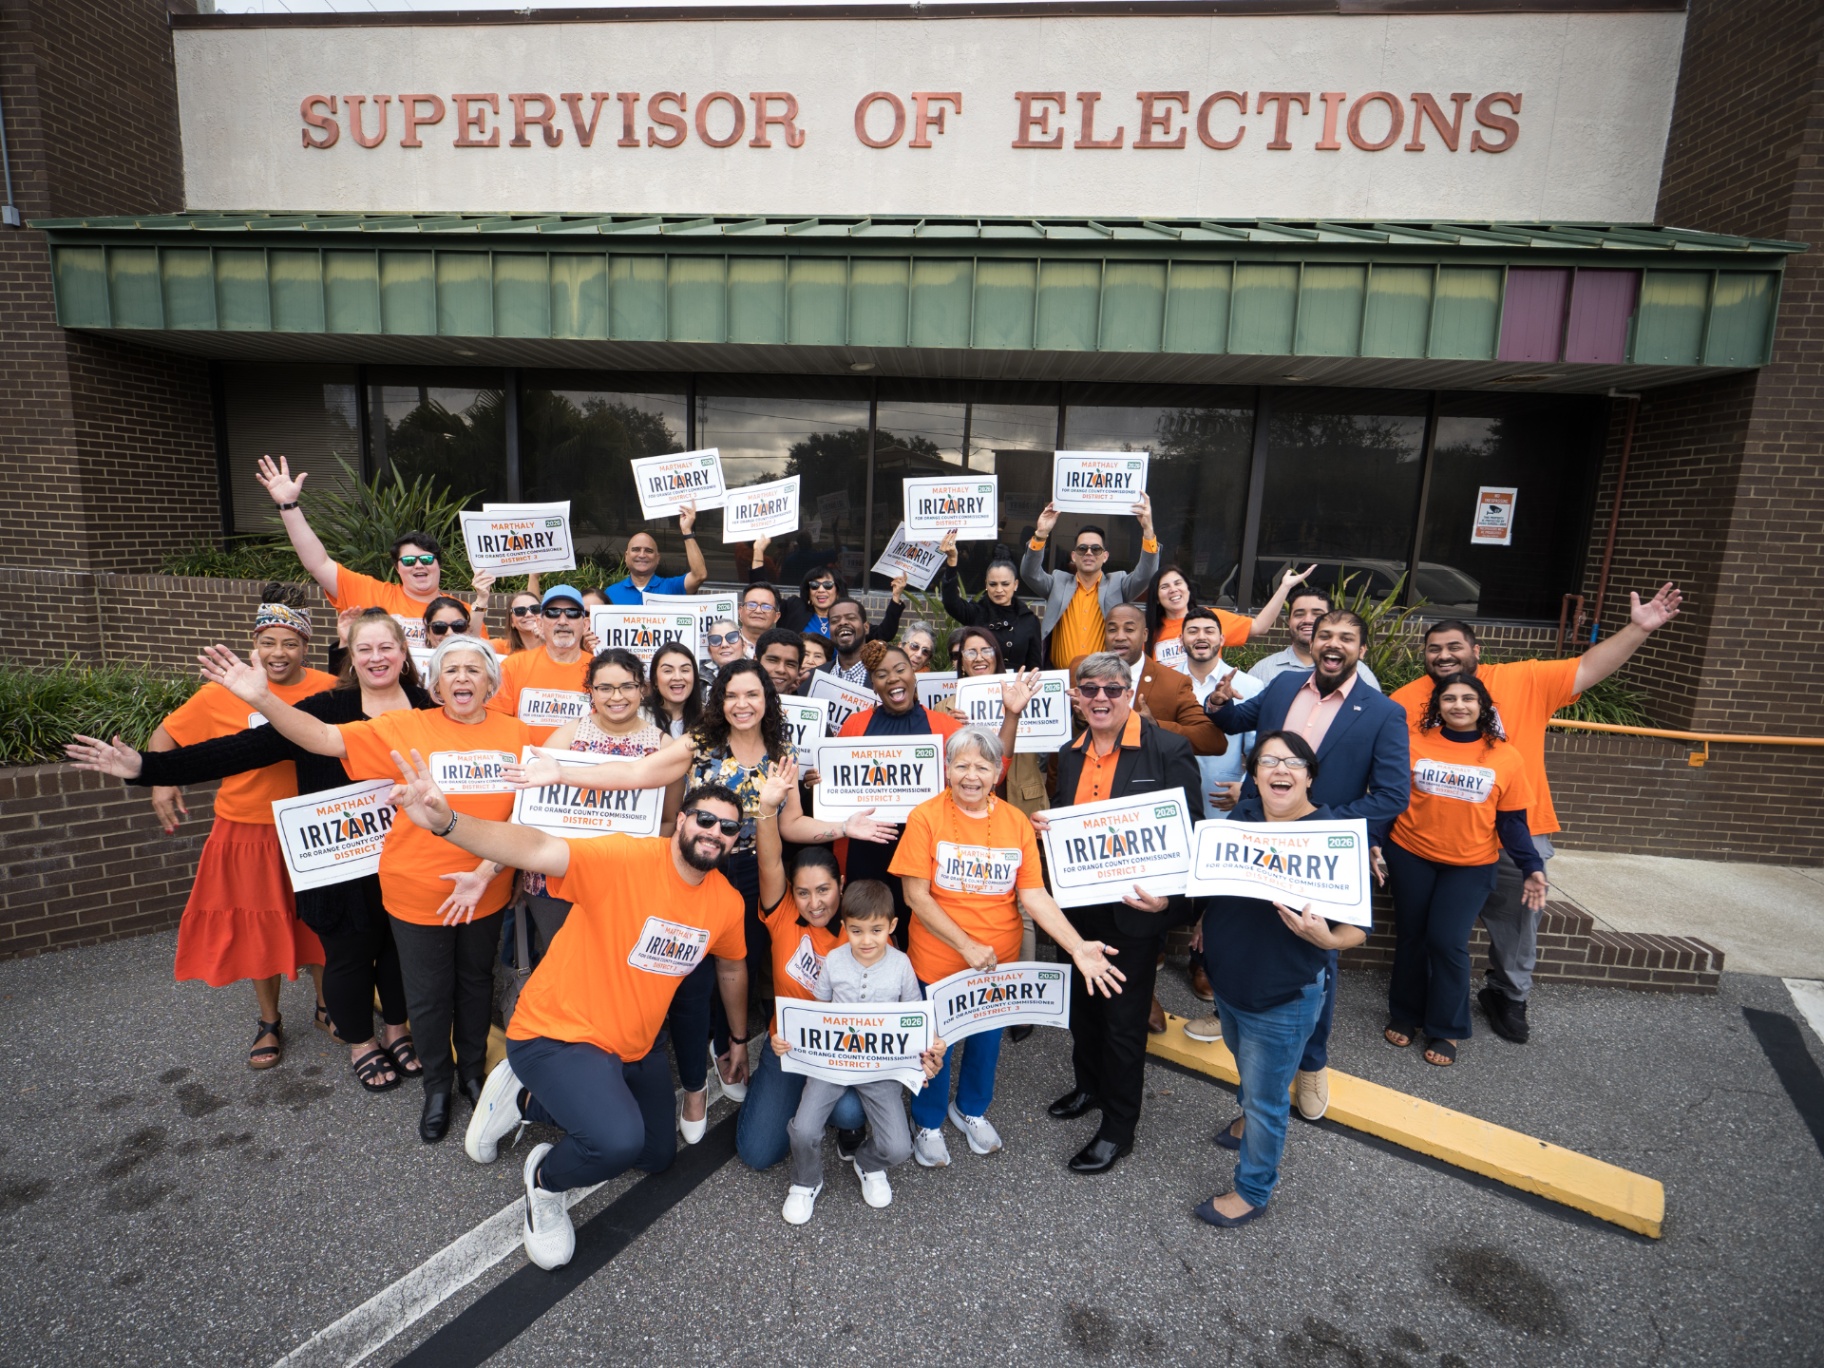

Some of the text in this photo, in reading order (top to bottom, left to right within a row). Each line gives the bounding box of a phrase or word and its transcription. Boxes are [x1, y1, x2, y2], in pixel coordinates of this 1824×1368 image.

[300, 91, 1523, 152] SUPERVISOR OF ELECTIONS
[660, 462, 692, 471] MARTHALY
[649, 469, 708, 492] IRIZARRY
[1067, 472, 1132, 488] IRIZARRY
[736, 497, 788, 519] IRIZARRY
[920, 497, 984, 514] IRIZARRY
[491, 522, 534, 530] MARTHALY
[478, 531, 553, 552] IRIZARRY
[893, 541, 935, 567] IRIZARRY
[607, 629, 682, 646] IRIZARRY
[528, 700, 583, 716] IRIZARRY
[852, 749, 933, 758] MARTHALY 2026
[834, 764, 923, 786] IRIZARRY
[1423, 769, 1483, 790] IRIZARRY
[316, 794, 376, 816] MARTHALY
[539, 784, 642, 811] IRIZARRY
[545, 806, 571, 814] ORANGE
[600, 812, 647, 820] COMMISSIONER
[563, 816, 603, 826] DISTRICT
[1083, 806, 1176, 829] MARTHALY 2026
[314, 846, 340, 856] ORANGE
[342, 838, 368, 850] COUNTY
[1066, 825, 1166, 864] IRIZARRY
[1243, 834, 1353, 848] MARTHALY 2026
[334, 844, 376, 860] DISTRICT
[1216, 842, 1339, 880] IRIZARRY
[947, 858, 1010, 879] IRIZARRY
[1078, 863, 1103, 871] ORANGE
[1105, 859, 1130, 867] COUNTY
[1131, 852, 1181, 864] COMMISSIONER
[1098, 867, 1137, 878] DISTRICT
[1223, 863, 1253, 871] ORANGE
[1257, 868, 1287, 880] COUNTY
[1289, 877, 1350, 890] COMMISSIONER
[1246, 871, 1293, 889] DISTRICT
[665, 927, 693, 939] MARTHALY
[646, 936, 700, 961] IRIZARRY
[653, 962, 673, 970] DISTRICT
[967, 973, 1024, 987] MARTHALY
[949, 983, 1046, 1016] IRIZARRY
[823, 1017, 922, 1026] MARTHALY 2026
[944, 1017, 954, 1025] FOR
[956, 1008, 980, 1019] ORANGE
[982, 1002, 1006, 1010] COUNTY
[974, 1006, 1011, 1019] DISTRICT
[801, 1028, 909, 1054] IRIZARRY
[829, 1060, 870, 1068] DISTRICT
